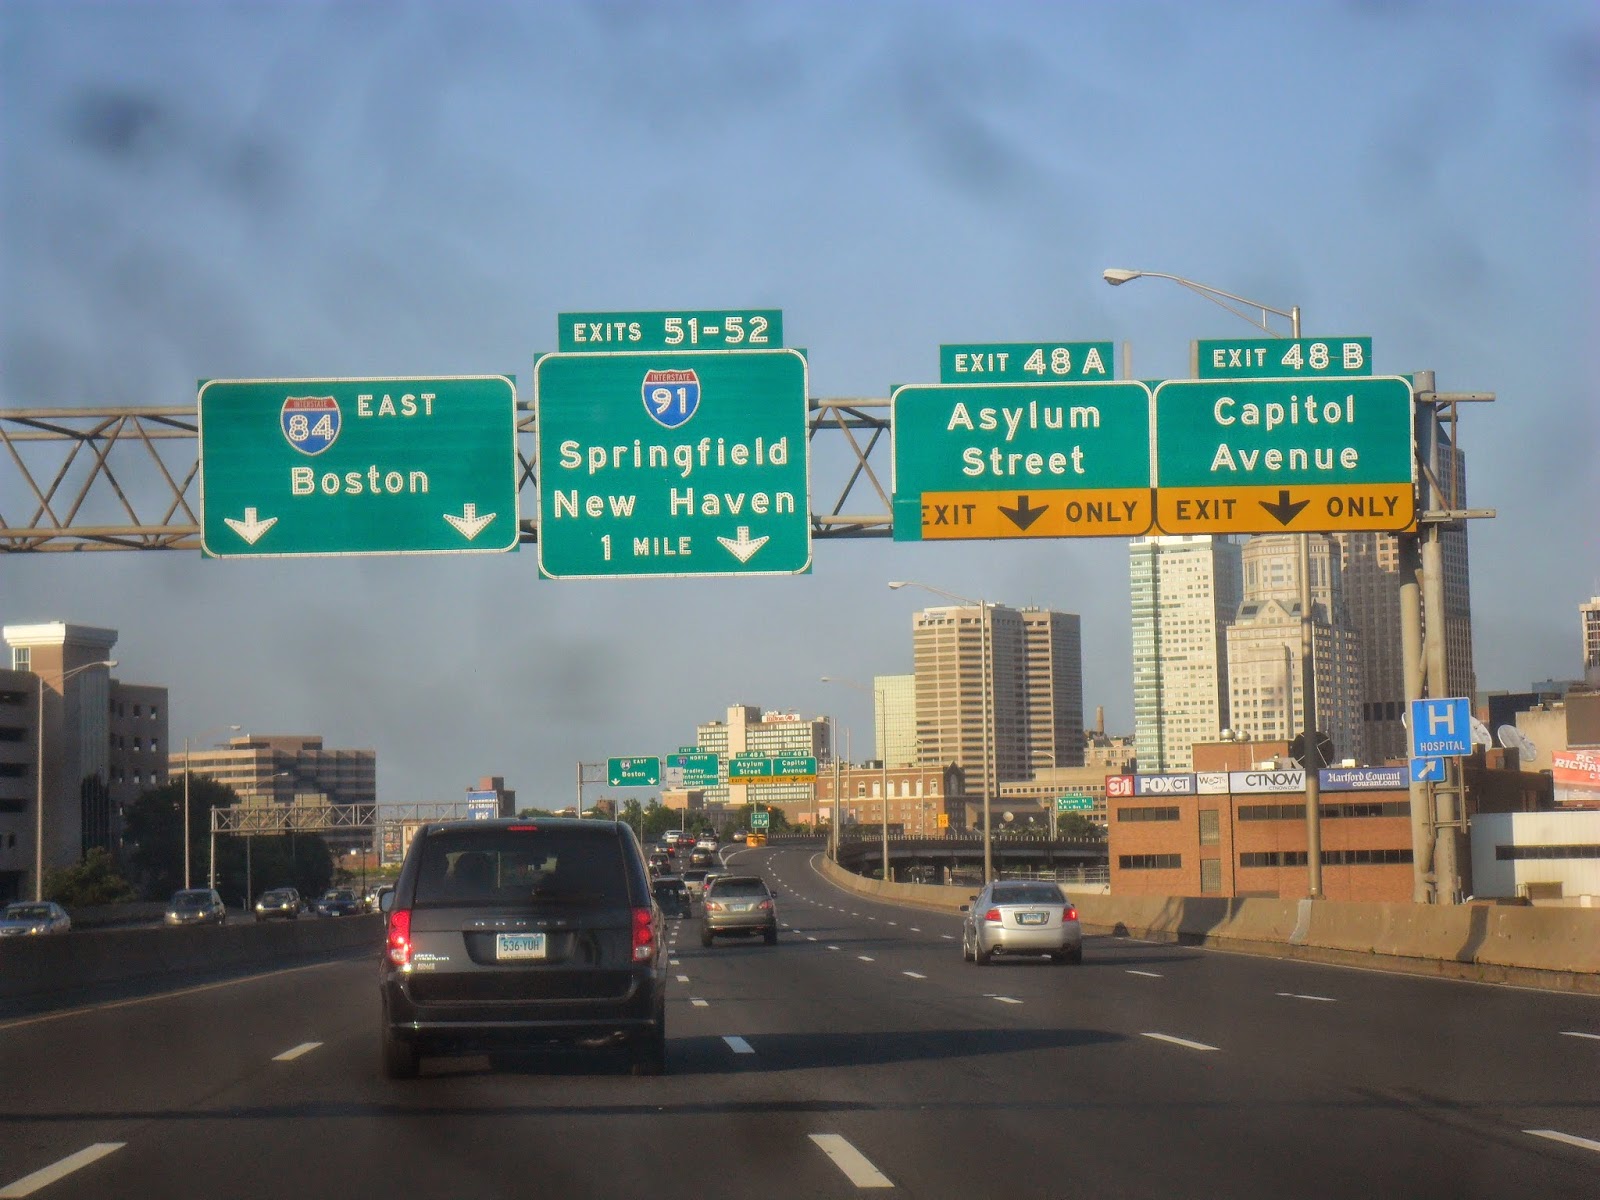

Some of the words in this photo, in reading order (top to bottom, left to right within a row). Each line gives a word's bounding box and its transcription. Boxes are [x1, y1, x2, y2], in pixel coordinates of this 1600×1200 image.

[573, 322, 642, 342] EXITS
[664, 316, 769, 344] 51-52
[955, 352, 1009, 373] EXIT
[1023, 348, 1072, 375] 48
[1082, 347, 1106, 375] A
[1213, 348, 1267, 368] EXIT
[1281, 343, 1329, 370] 48
[1342, 342, 1364, 369] B
[651, 373, 691, 382] INTERSTATE
[293, 399, 329, 408] INTERSTATE
[357, 393, 436, 416] EAST
[652, 387, 686, 414] 91
[1213, 394, 1355, 432] Capitol
[288, 414, 335, 441] 84
[946, 401, 1100, 441] Asylum
[559, 436, 788, 478] Springfield
[962, 445, 1085, 476] Street
[1210, 443, 1359, 472] Avenue
[291, 465, 429, 495] Boston
[554, 489, 636, 518] New
[670, 487, 795, 516] Haven
[1065, 500, 1138, 523] ONLY
[1177, 499, 1237, 521] EXIT
[1326, 495, 1399, 517] ONLY
[601, 534, 612, 560] 1
[633, 536, 692, 556] MILE
[1428, 704, 1455, 735] H
[1420, 740, 1465, 752] HOSPITAL
[1245, 772, 1302, 786] CTNOW
[1327, 771, 1364, 783] Hartford
[1366, 771, 1400, 781] Courant
[503, 940, 539, 952] 536-YUH
